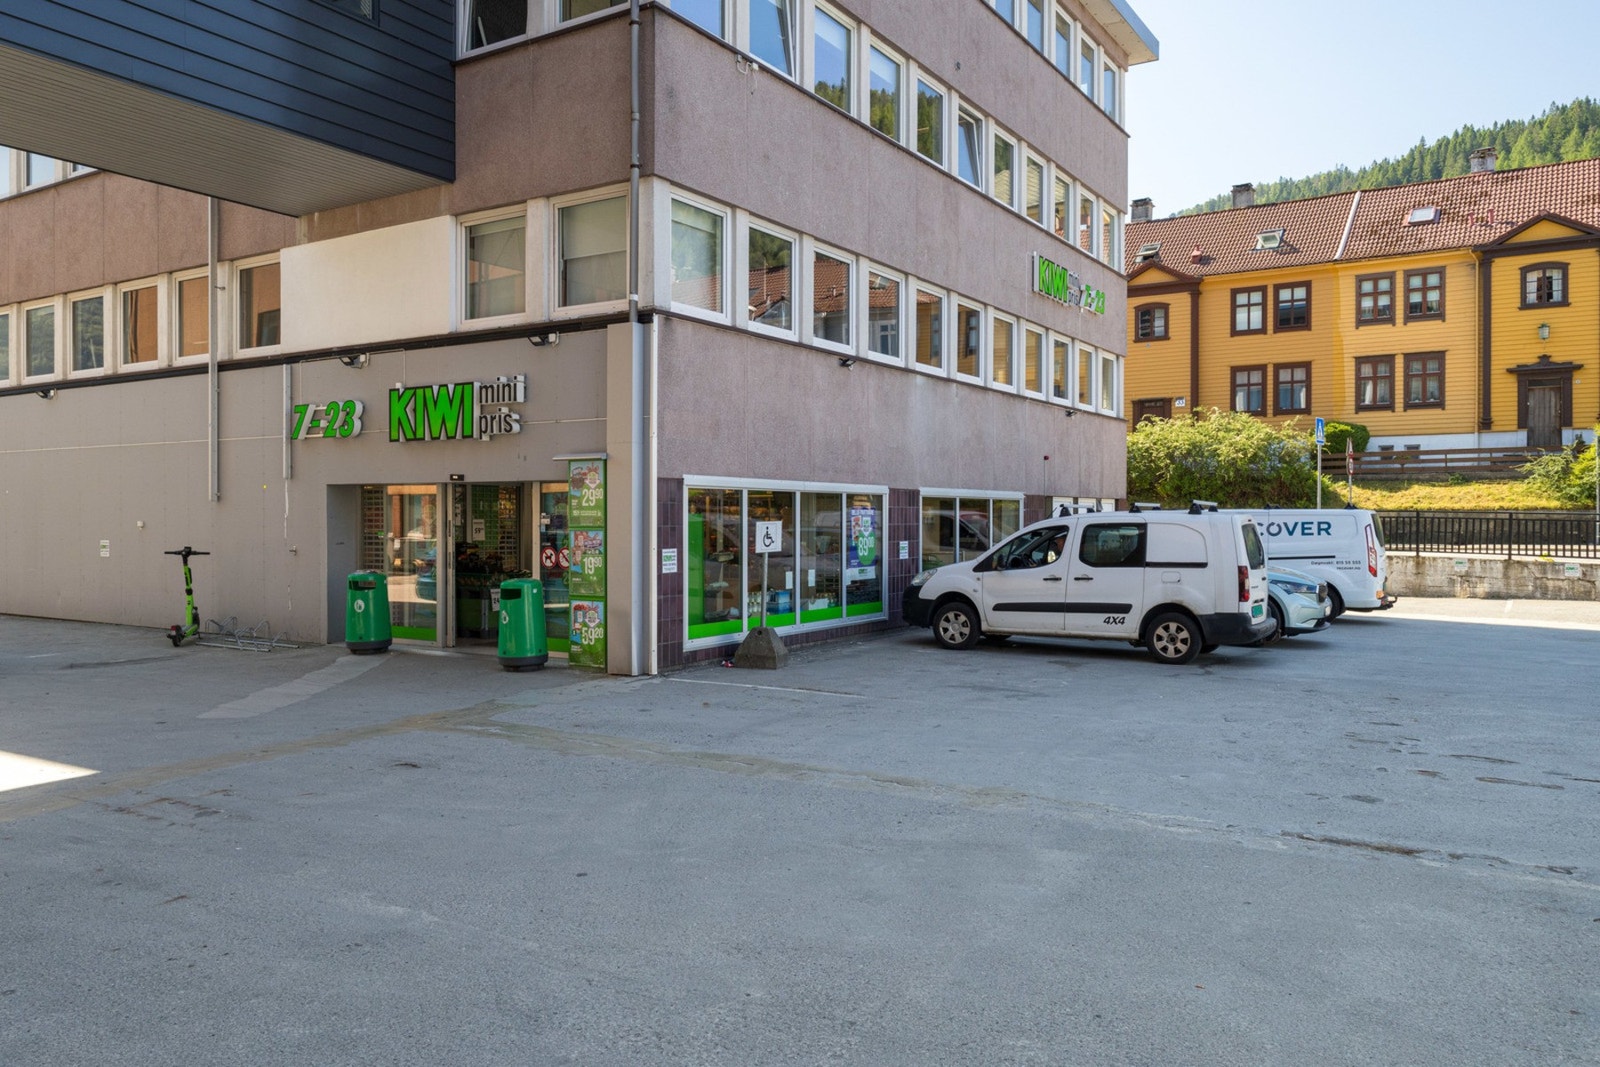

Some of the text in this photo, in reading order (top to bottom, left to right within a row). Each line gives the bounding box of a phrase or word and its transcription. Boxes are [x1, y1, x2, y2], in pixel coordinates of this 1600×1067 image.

[1039, 255, 1067, 303] KIWI
[1083, 284, 1105, 314] 7-23
[479, 375, 520, 403] mini
[292, 399, 357, 440] 7-23
[389, 381, 474, 442] KIWI
[479, 407, 514, 440] pris
